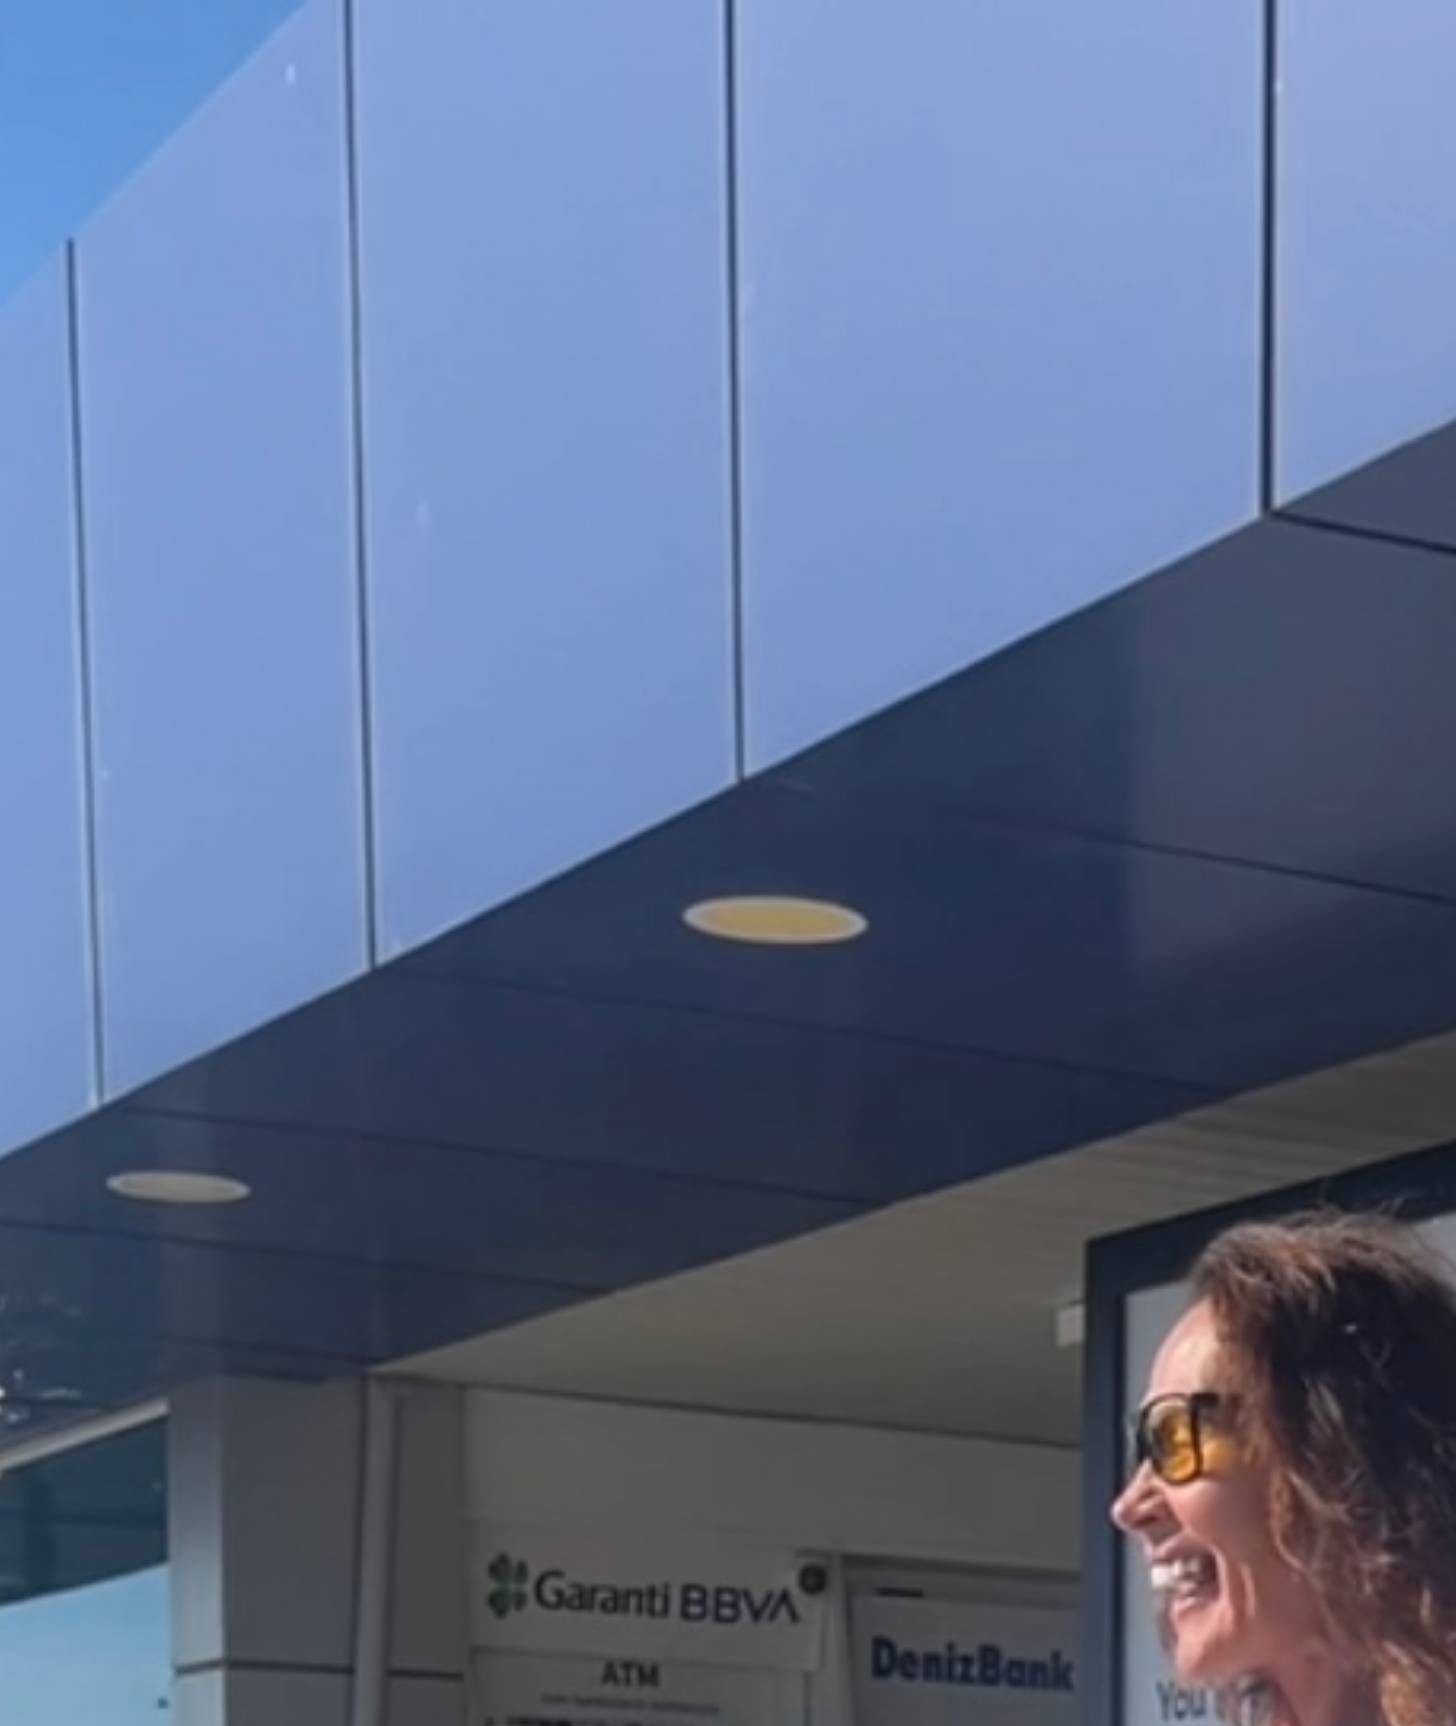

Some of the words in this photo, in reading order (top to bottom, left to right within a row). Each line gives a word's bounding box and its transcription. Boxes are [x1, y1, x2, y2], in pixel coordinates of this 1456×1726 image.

[535, 1569, 671, 1619] Garanti
[681, 1583, 801, 1624] BBVA
[601, 1661, 659, 1687] ATM
[871, 1636, 1074, 1691] DenizBank
[1156, 1682, 1206, 1720] You
